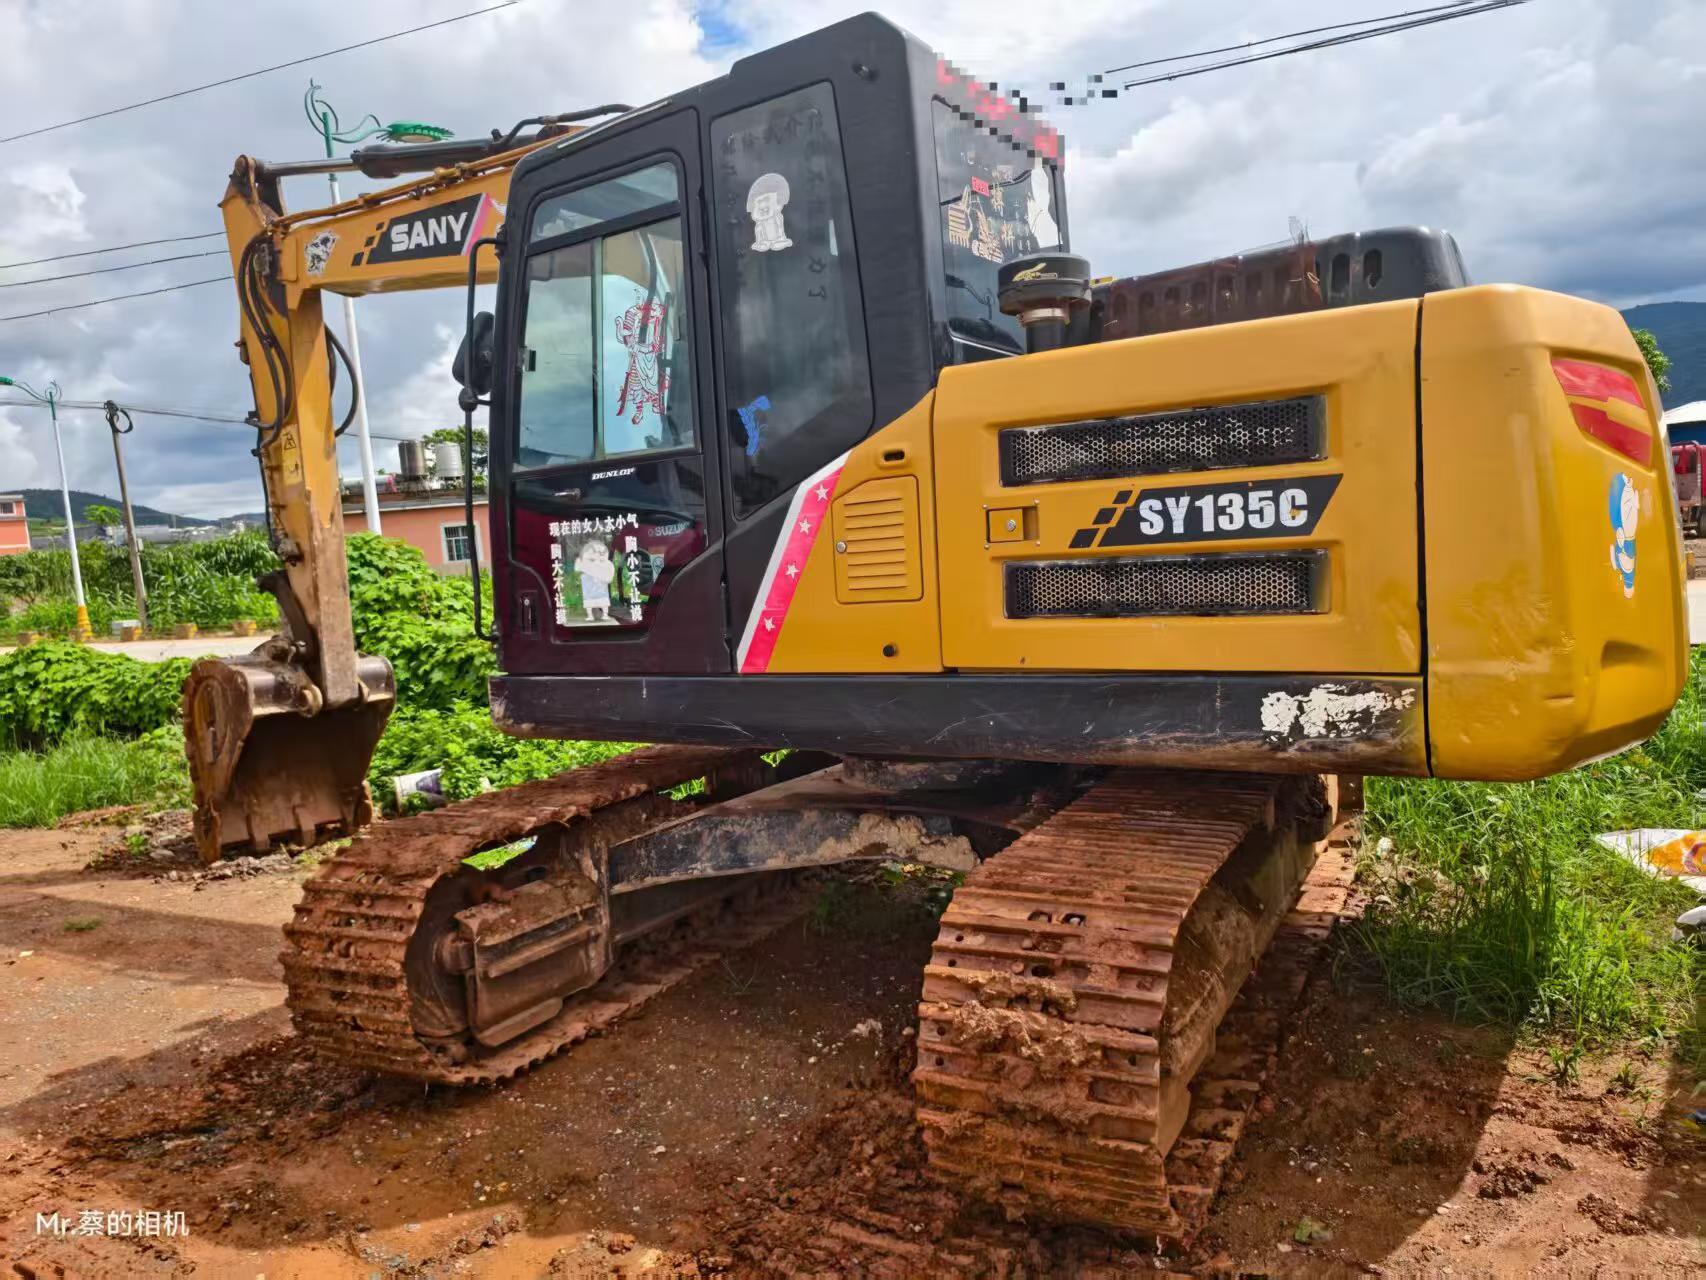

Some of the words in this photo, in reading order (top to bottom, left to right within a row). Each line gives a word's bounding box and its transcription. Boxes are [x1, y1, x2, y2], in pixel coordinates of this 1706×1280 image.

[391, 212, 468, 252] SANY
[591, 467, 636, 481] DUNLOP
[548, 513, 639, 537] 现在的女人太小气
[1139, 488, 1308, 535] SY135C
